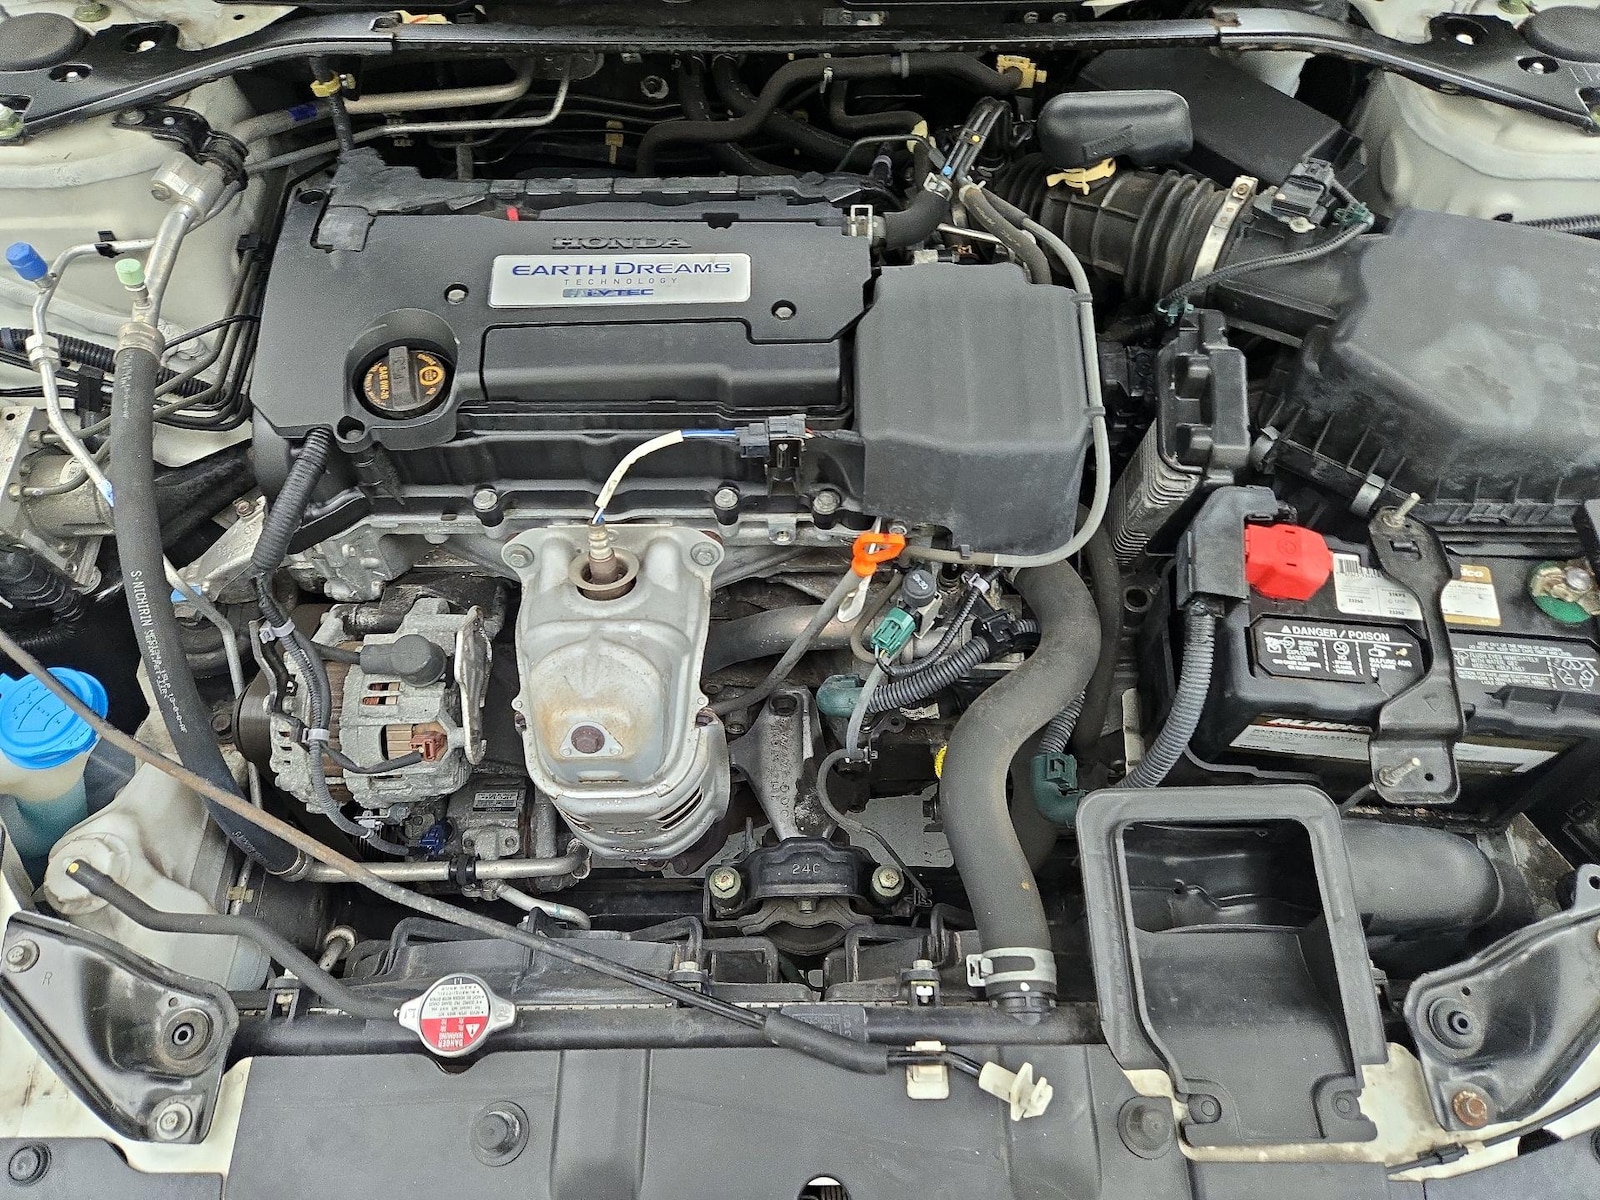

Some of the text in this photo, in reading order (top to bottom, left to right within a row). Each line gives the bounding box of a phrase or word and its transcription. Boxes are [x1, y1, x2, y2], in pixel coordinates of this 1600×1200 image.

[552, 237, 692, 250] HONDA
[512, 262, 731, 276] EARTH DREAMS
[564, 277, 679, 286] TECHNOLOGY
[1292, 625, 1338, 639] DANGER
[1348, 630, 1390, 642] POISON
[792, 862, 821, 875] 24C
